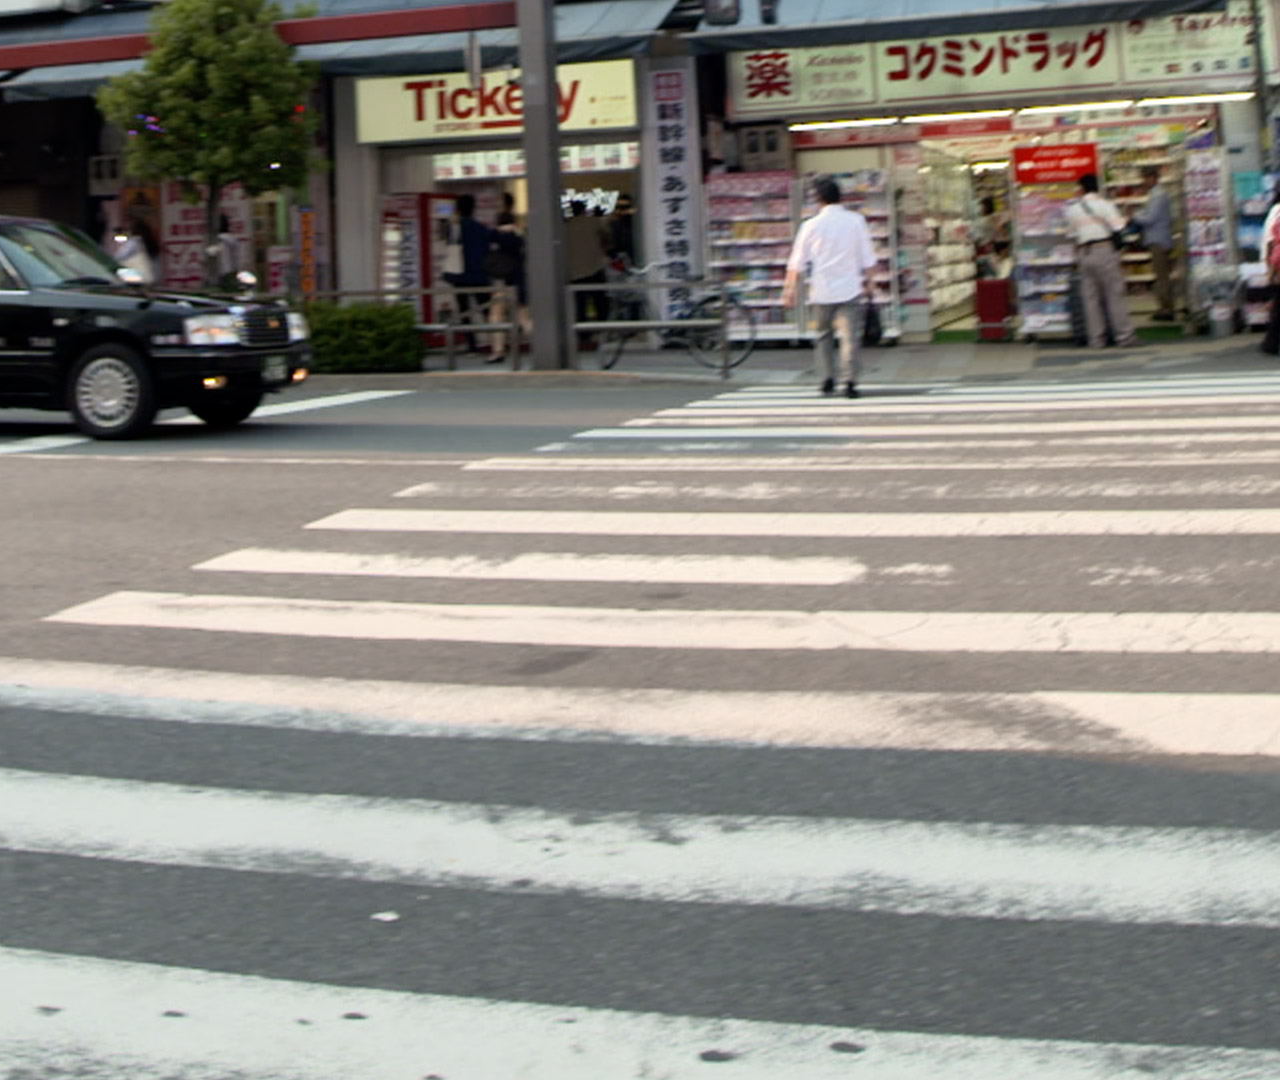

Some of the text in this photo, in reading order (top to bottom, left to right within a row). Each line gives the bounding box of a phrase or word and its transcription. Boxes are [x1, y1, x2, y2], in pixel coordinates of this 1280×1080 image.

[744, 51, 792, 98] 薬
[885, 28, 1110, 82] コクミンドラッグ
[403, 78, 581, 124] Tickey
